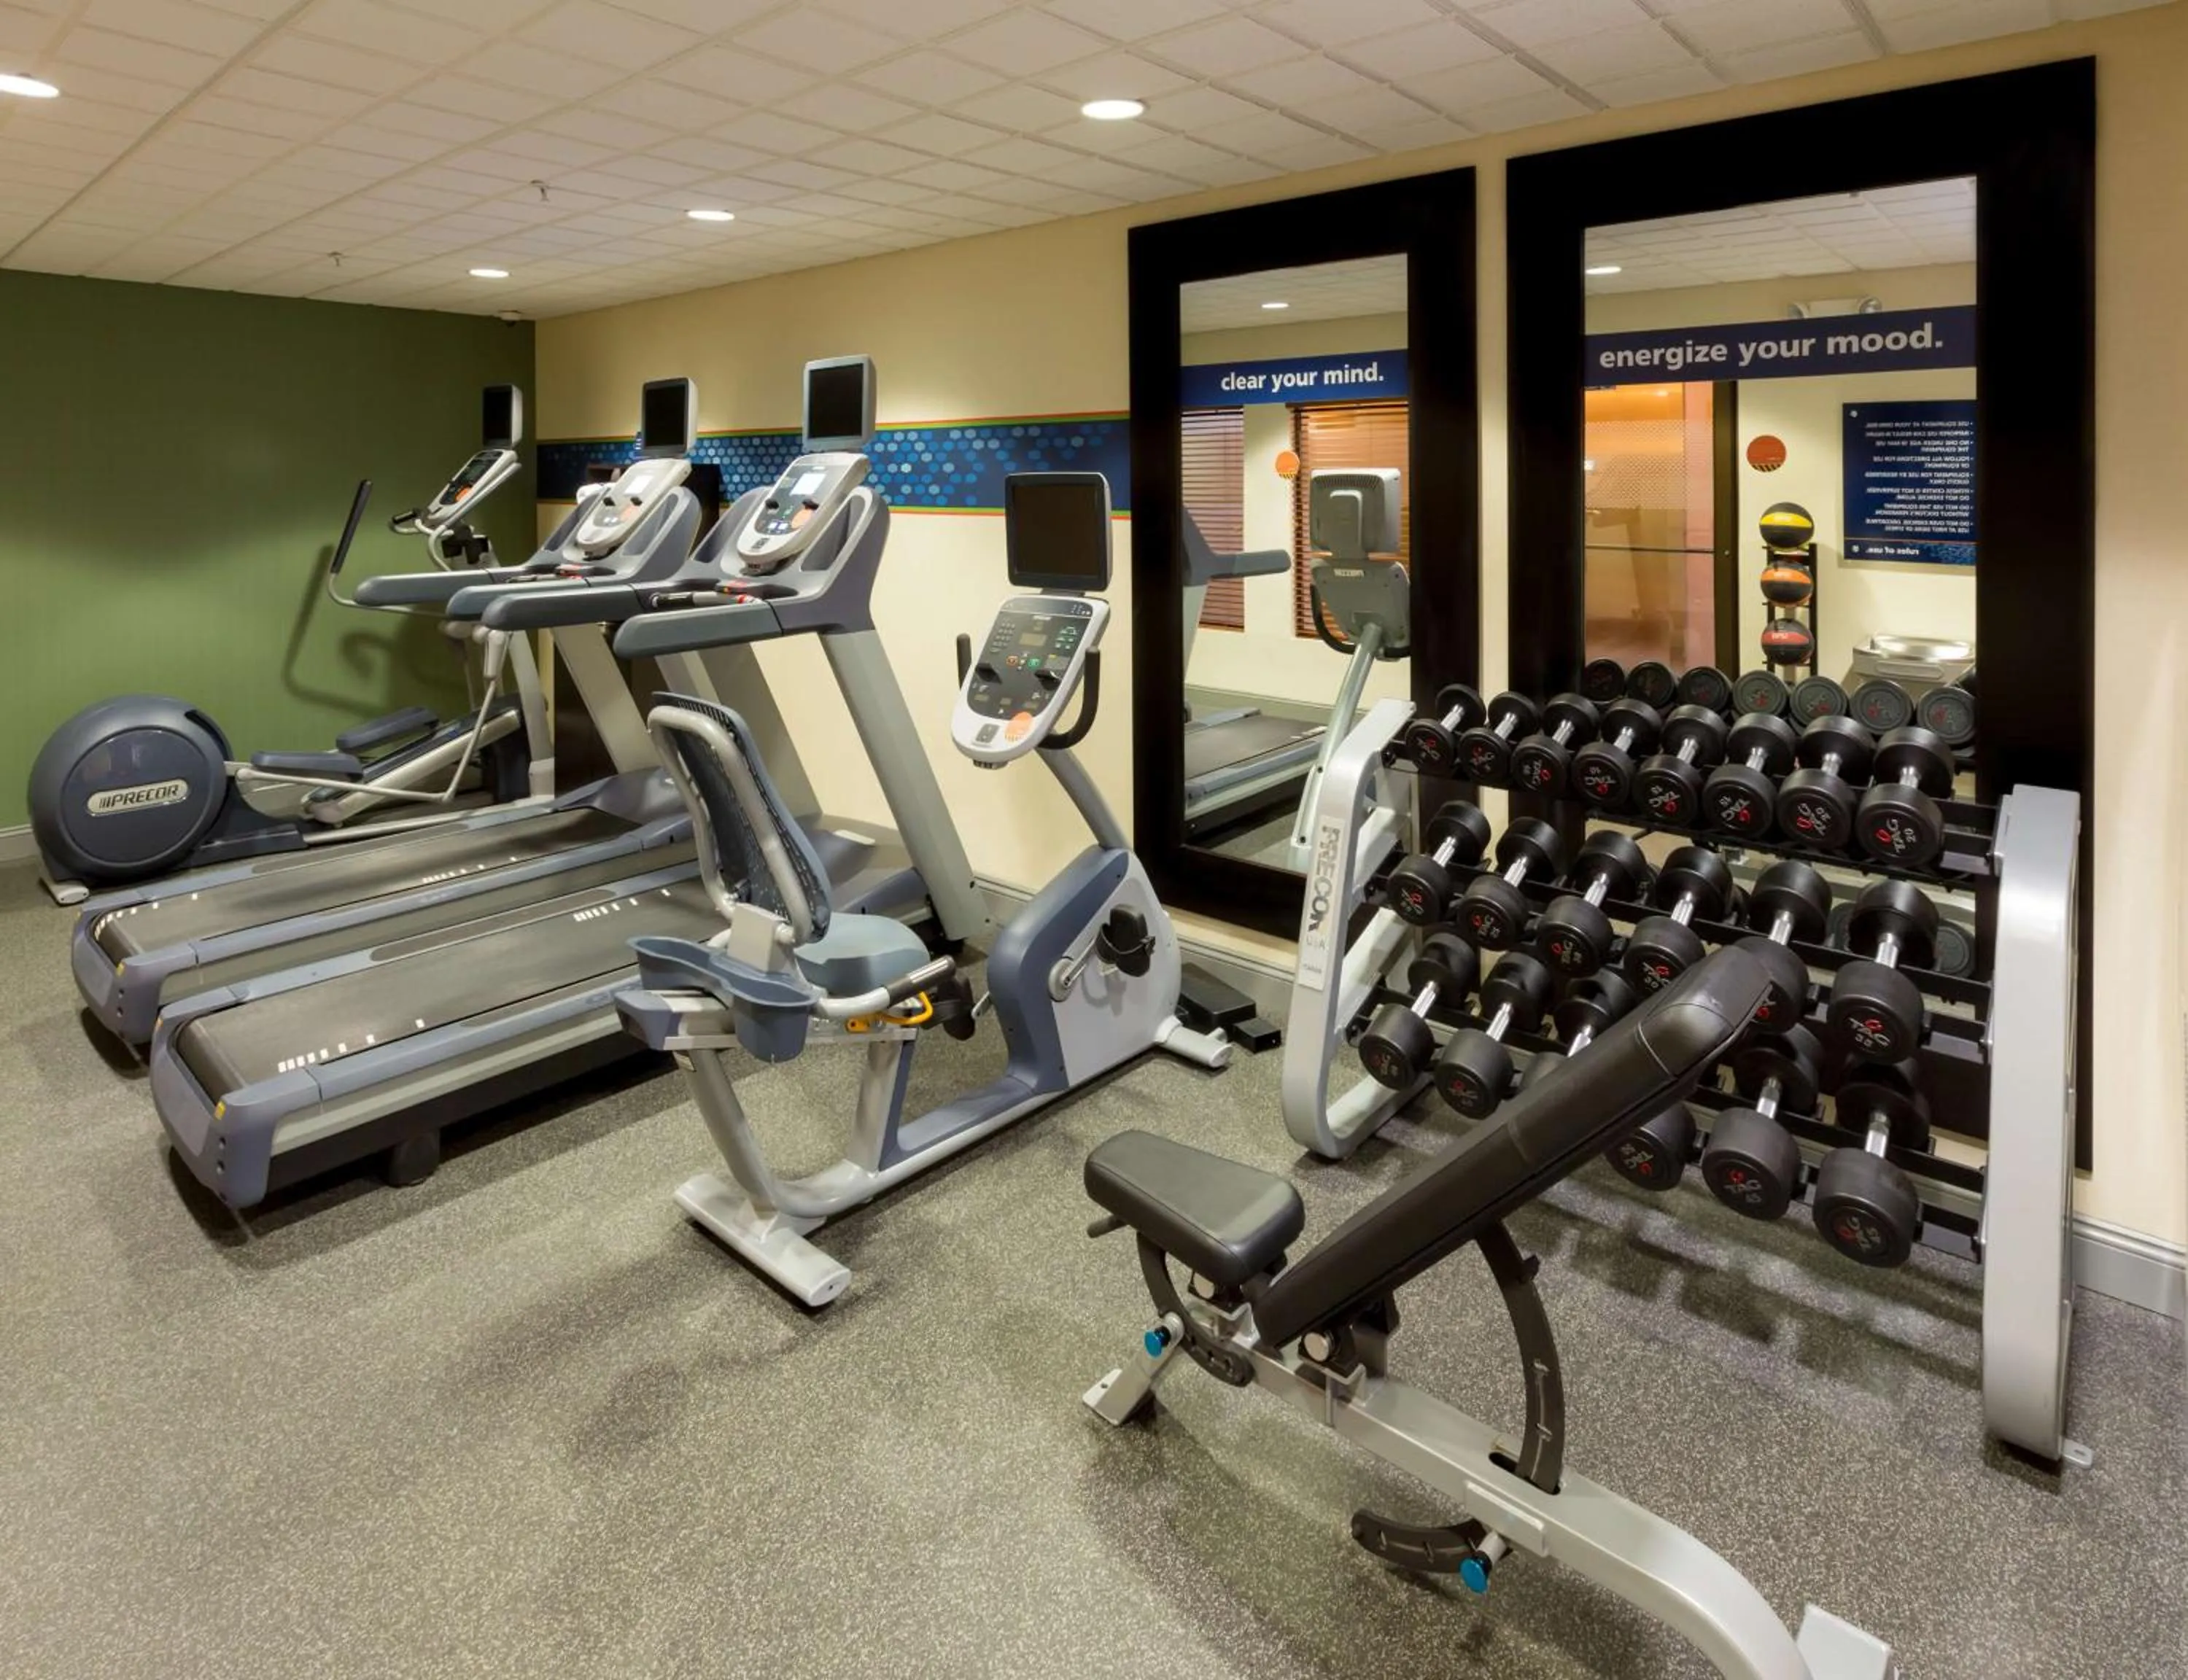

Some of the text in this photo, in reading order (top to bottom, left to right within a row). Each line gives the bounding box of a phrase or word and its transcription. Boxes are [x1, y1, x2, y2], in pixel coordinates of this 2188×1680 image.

[1599, 322, 1944, 370] energize your mood.
[1221, 362, 1385, 393] clear your mind.
[109, 784, 179, 809] PRECOR
[1720, 798, 1752, 822] TAG
[1797, 801, 1826, 837] TAG
[1886, 817, 1907, 854] TAG
[1903, 827, 1917, 844] 20
[1847, 1016, 1891, 1049] TAG
[1723, 1178, 1763, 1194] TAG
